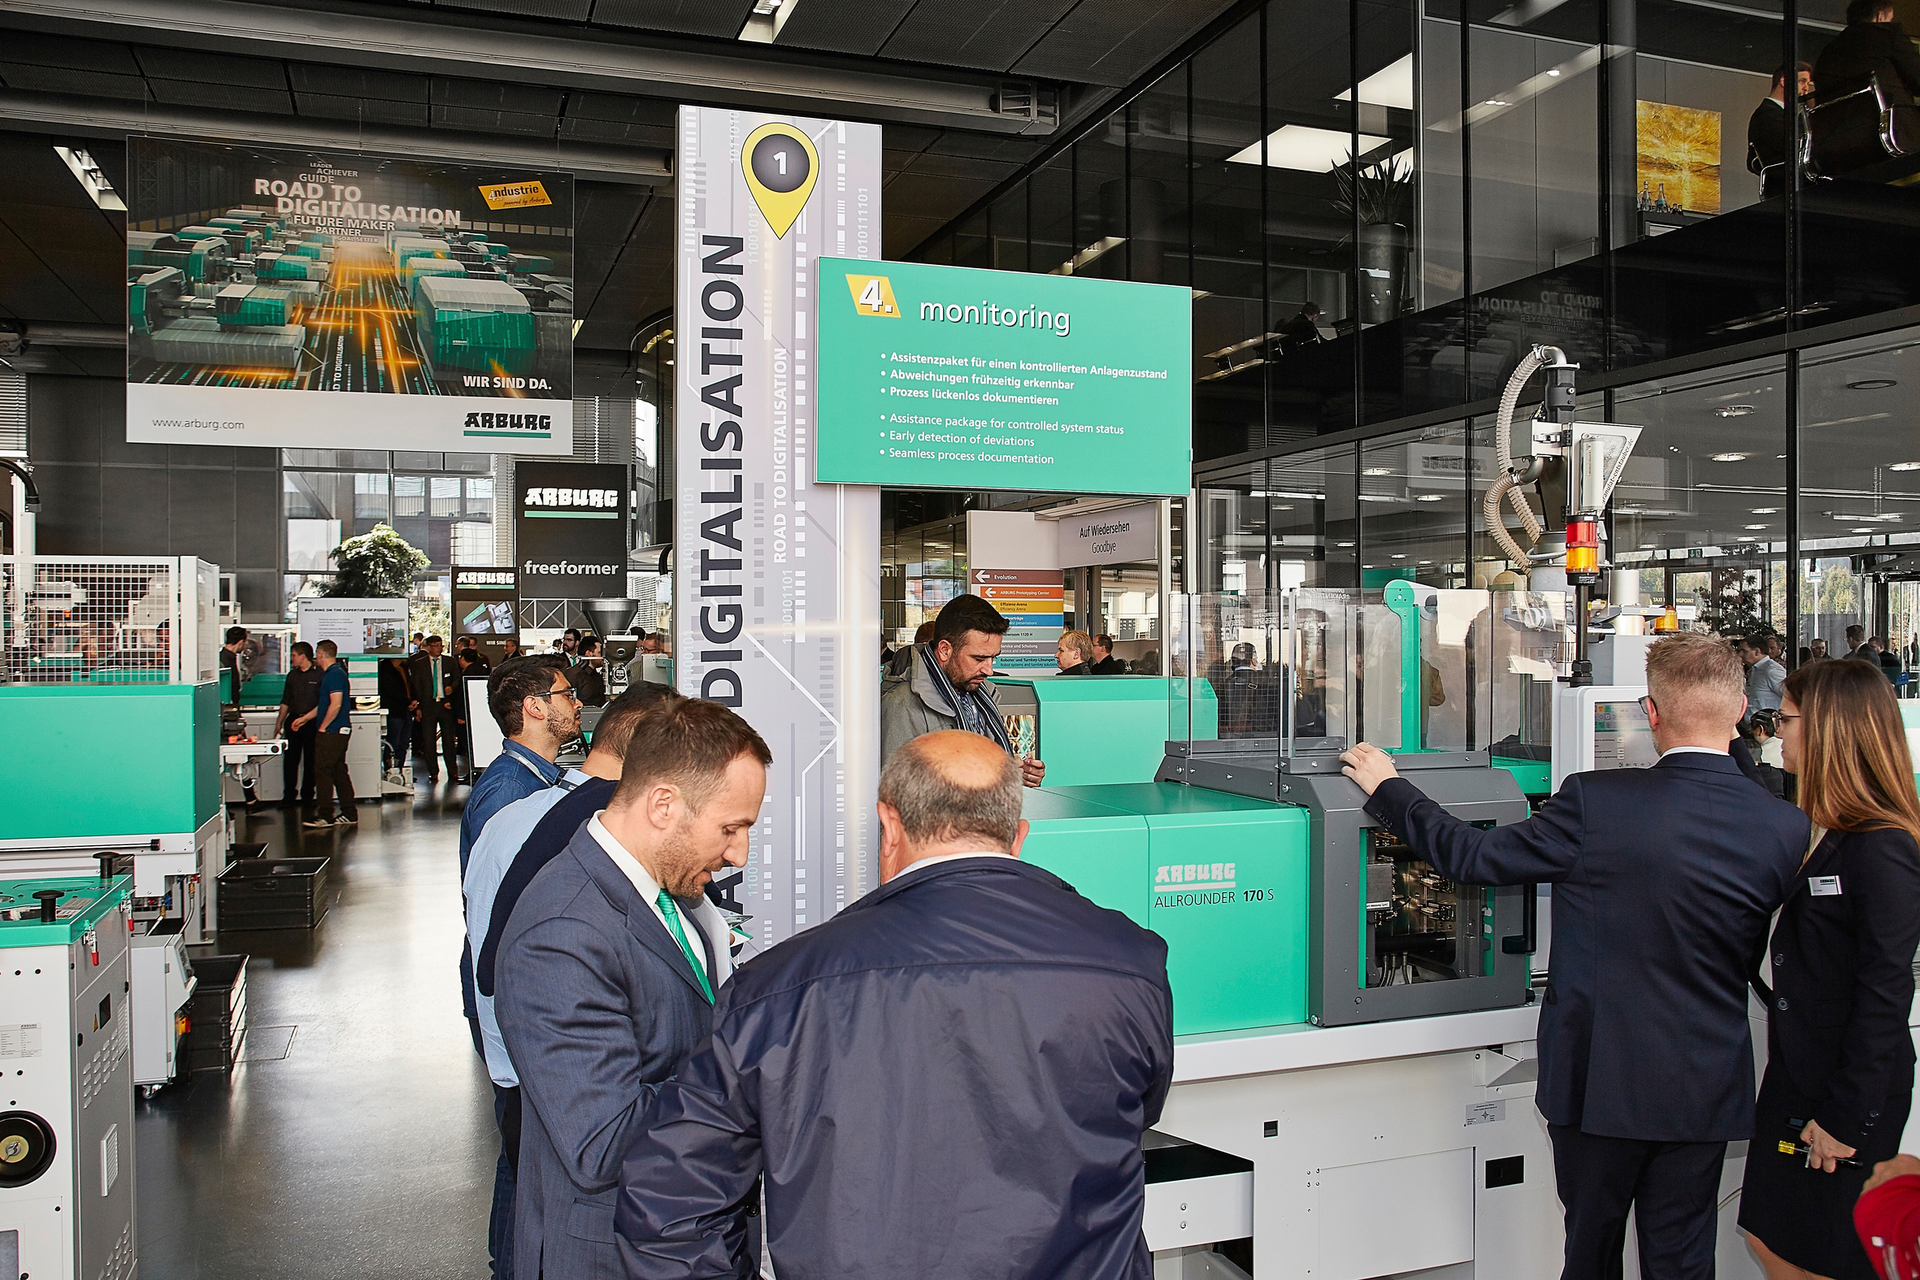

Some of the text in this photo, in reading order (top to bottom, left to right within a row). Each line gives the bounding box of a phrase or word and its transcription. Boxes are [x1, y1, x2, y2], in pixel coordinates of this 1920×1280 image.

[773, 151, 787, 175] 1
[299, 173, 335, 184] GUIDE
[316, 168, 358, 178] ACHIEVER
[254, 178, 362, 202] ROAD TO
[277, 197, 461, 226] DIGITALISATION
[293, 215, 396, 231] FUTURE MAKER
[315, 227, 362, 237] PARTNER
[859, 280, 893, 313] 4.
[920, 300, 1071, 337] monitoring
[890, 352, 1168, 380] Assistenzpaket für einen kontrollierten Anlagenzustand
[463, 375, 552, 390] WIR SIND DA.
[890, 369, 1075, 390] Abweichungen frühzeitig erkennbar
[890, 386, 1059, 405] Prozess lückenlos dokumentieren
[152, 419, 245, 431] www.arburg.com
[464, 412, 551, 431] ARBURG
[890, 413, 1125, 435] Assistance package for controlled system status
[889, 430, 1035, 447] Early detection of deviations
[773, 348, 787, 564] ROAD TO DIGITALISATION
[889, 447, 1054, 465] Seamless process documentation
[700, 235, 743, 707] DIGITALISATION
[524, 488, 619, 508] ARBURG
[1079, 521, 1130, 539] Auf Wiedersehen
[1091, 540, 1117, 555] Goodbye
[524, 560, 619, 575] freeformer
[456, 571, 515, 584] ARBURG
[1155, 863, 1236, 883] ARBURG
[1154, 888, 1274, 909] ALLROUNDER 170 S
